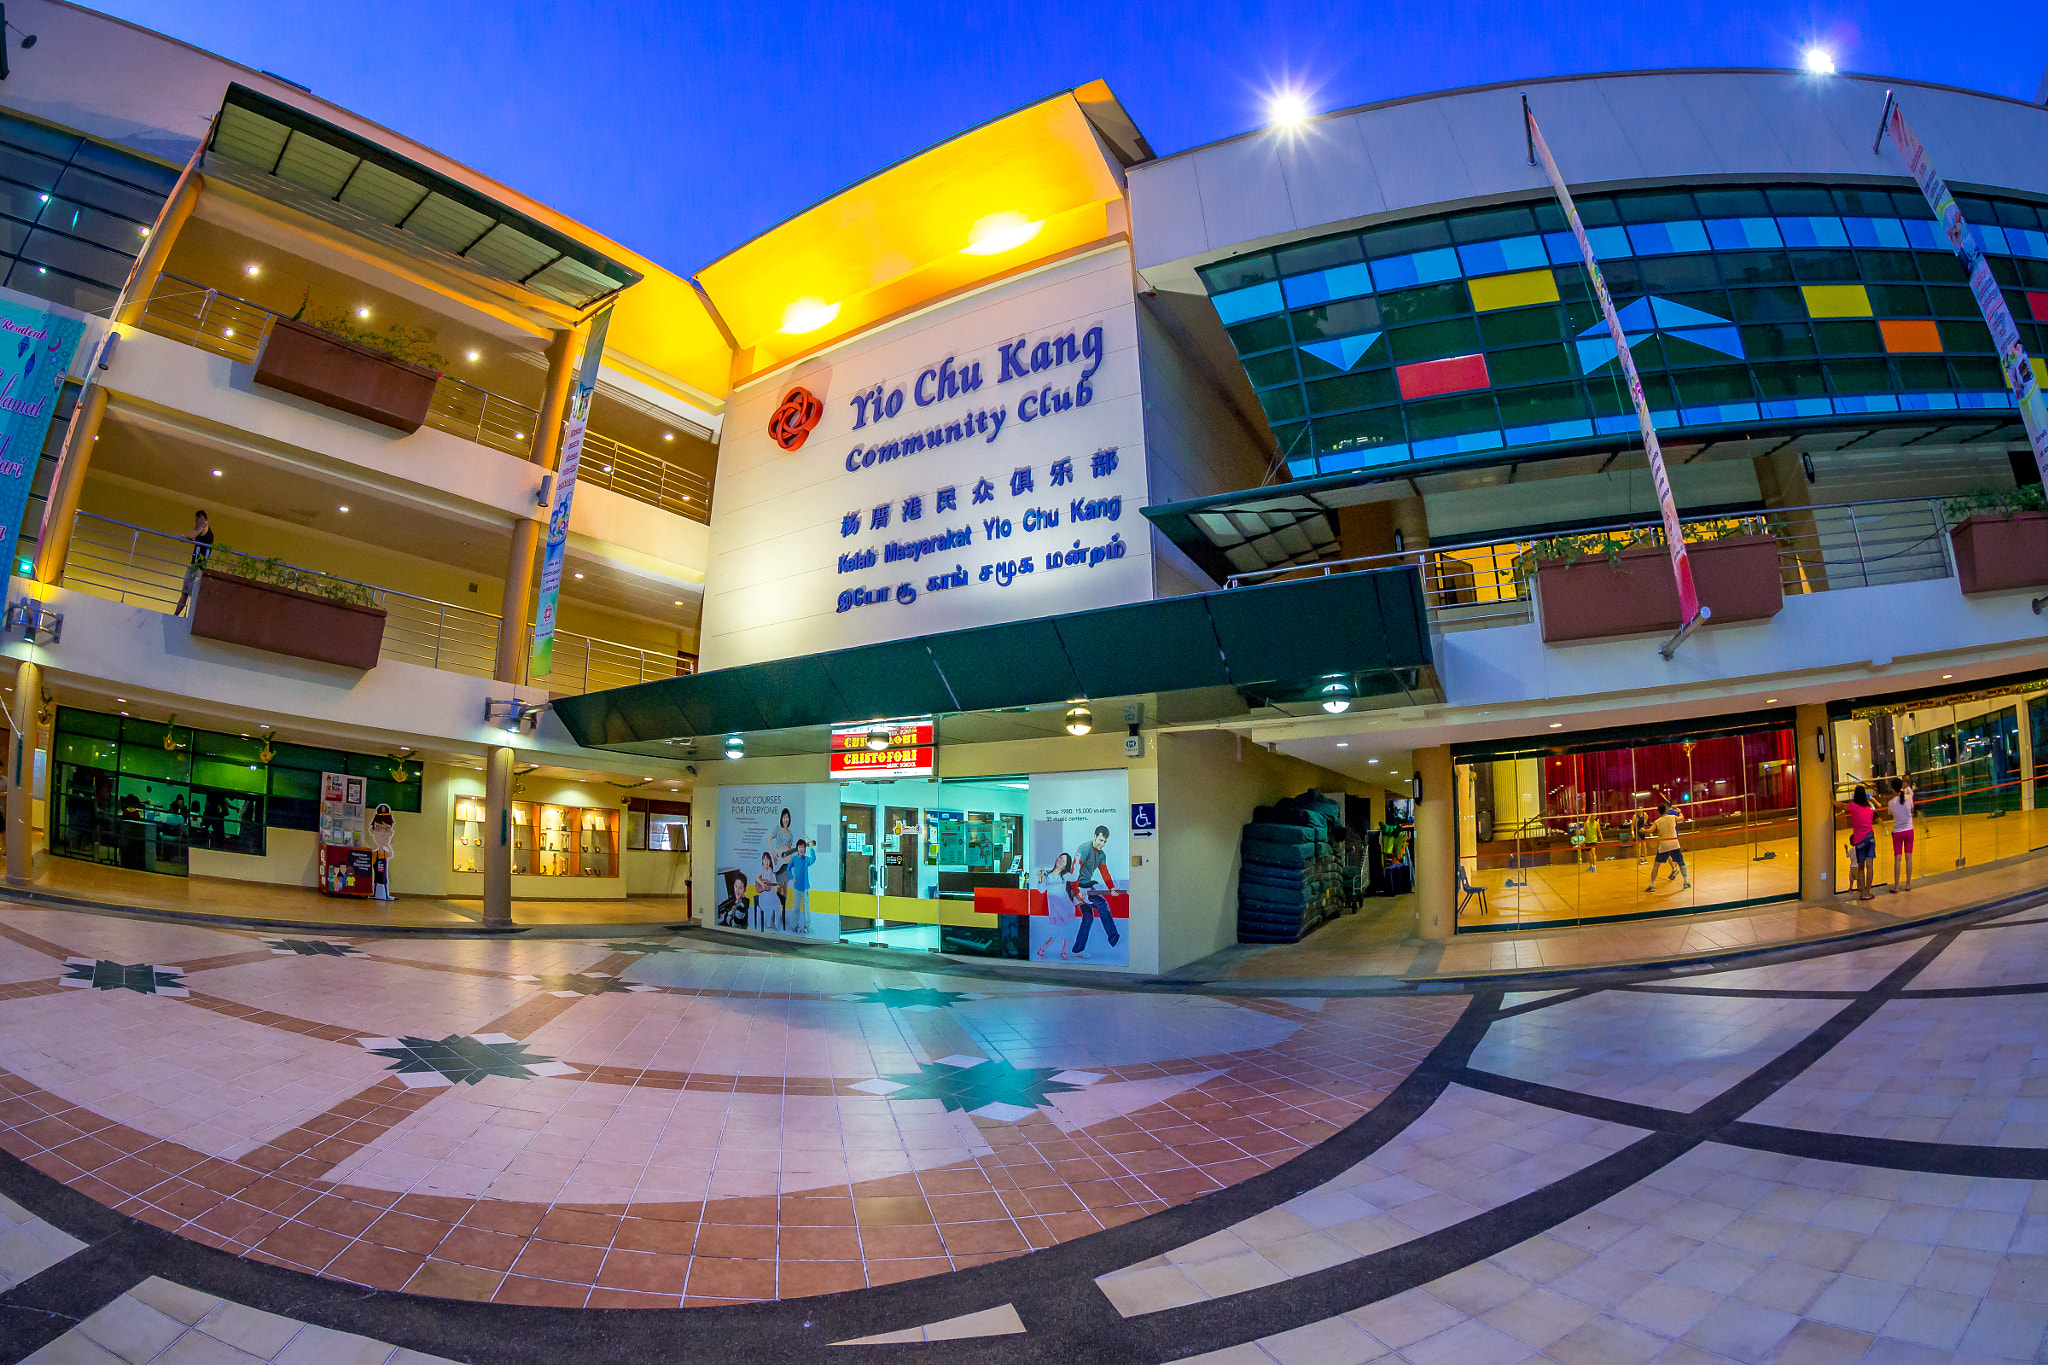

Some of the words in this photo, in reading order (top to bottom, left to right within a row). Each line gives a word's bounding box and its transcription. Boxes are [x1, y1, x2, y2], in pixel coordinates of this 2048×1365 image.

[1, 318, 49, 341] Residents
[850, 385, 903, 431] Yio
[914, 356, 983, 407] Chu
[997, 326, 1103, 384] Kang
[845, 409, 1006, 472] Community
[1017, 376, 1094, 423] Club
[838, 549, 877, 574] Kelab
[884, 527, 971, 562] Masyarakat
[1022, 508, 1060, 533] Chu
[1070, 497, 1122, 523] Kang
[844, 750, 917, 764] CRISTOFORI
[731, 796, 751, 804] MUSIC
[752, 795, 782, 804] COURSES
[731, 806, 744, 814] FOR
[745, 806, 779, 815] EVERYONE
